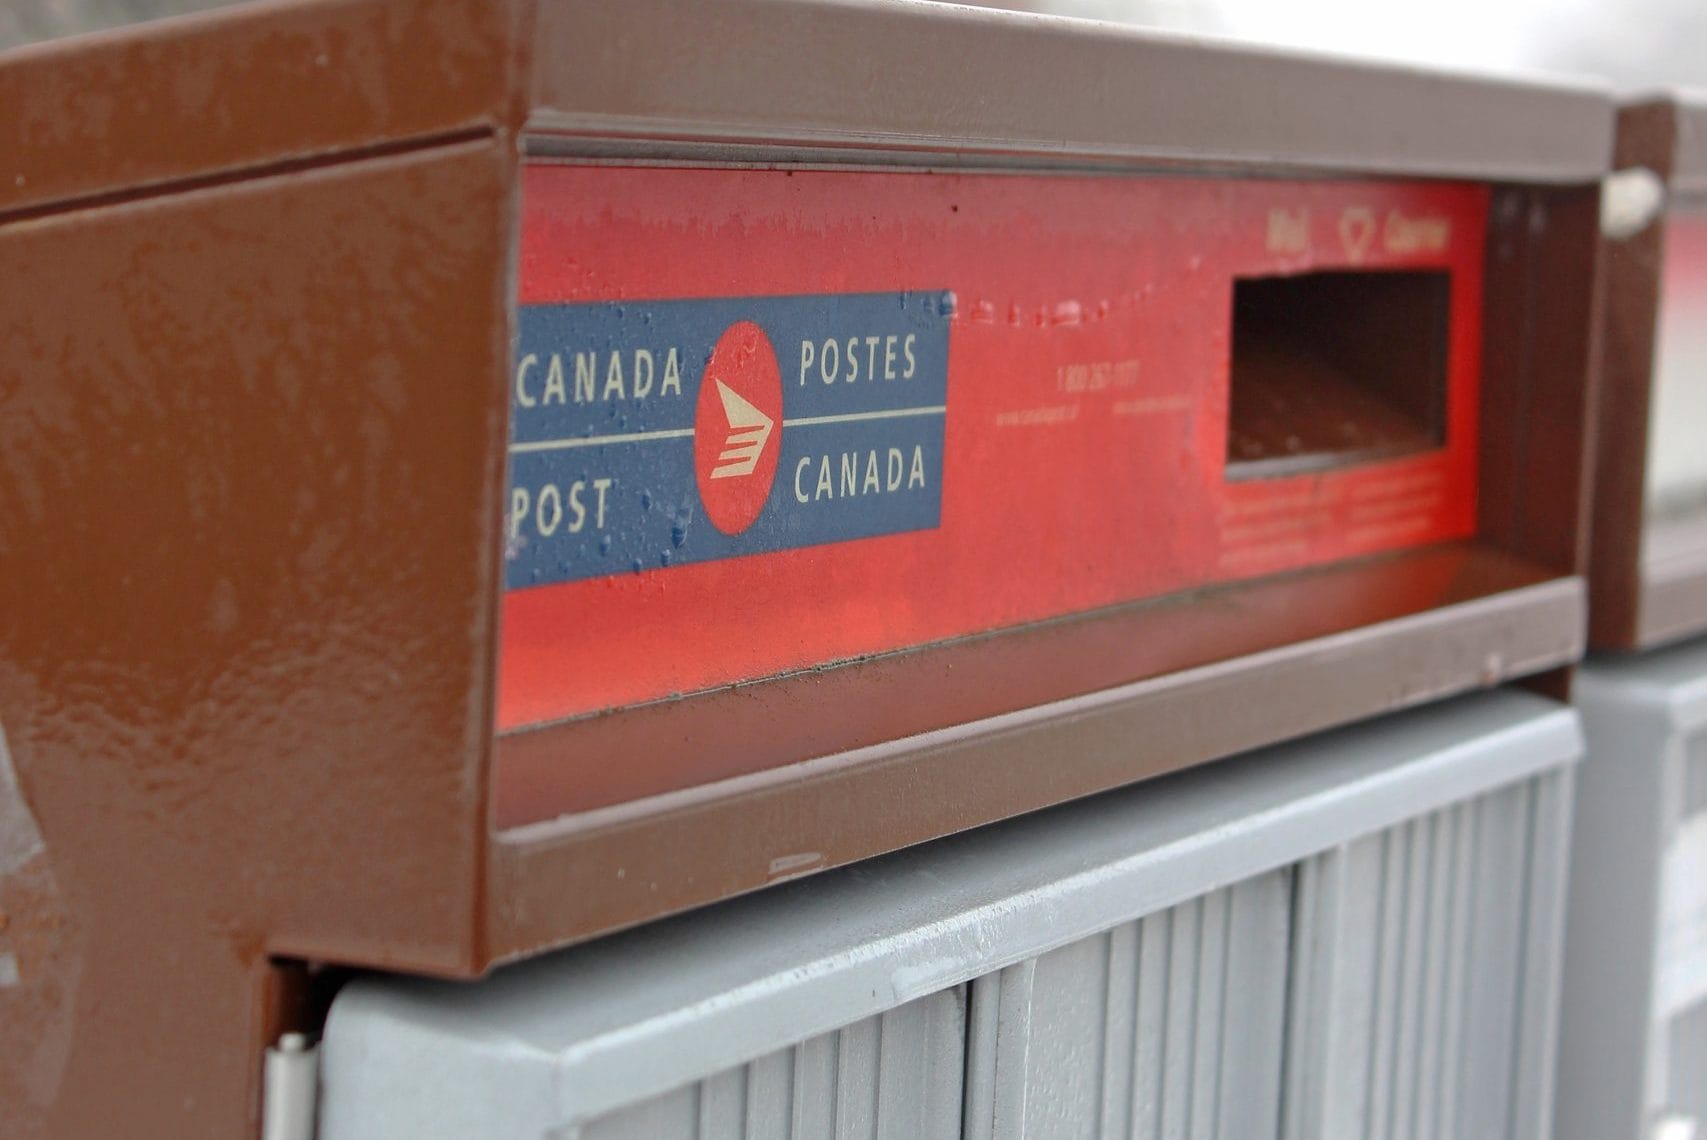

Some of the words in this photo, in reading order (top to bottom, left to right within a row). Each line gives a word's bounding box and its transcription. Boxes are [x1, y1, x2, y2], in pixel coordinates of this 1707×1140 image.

[516, 347, 682, 408] CANADA
[800, 334, 916, 386] POSTES
[794, 445, 925, 503] CANADA
[510, 478, 612, 539] POST
